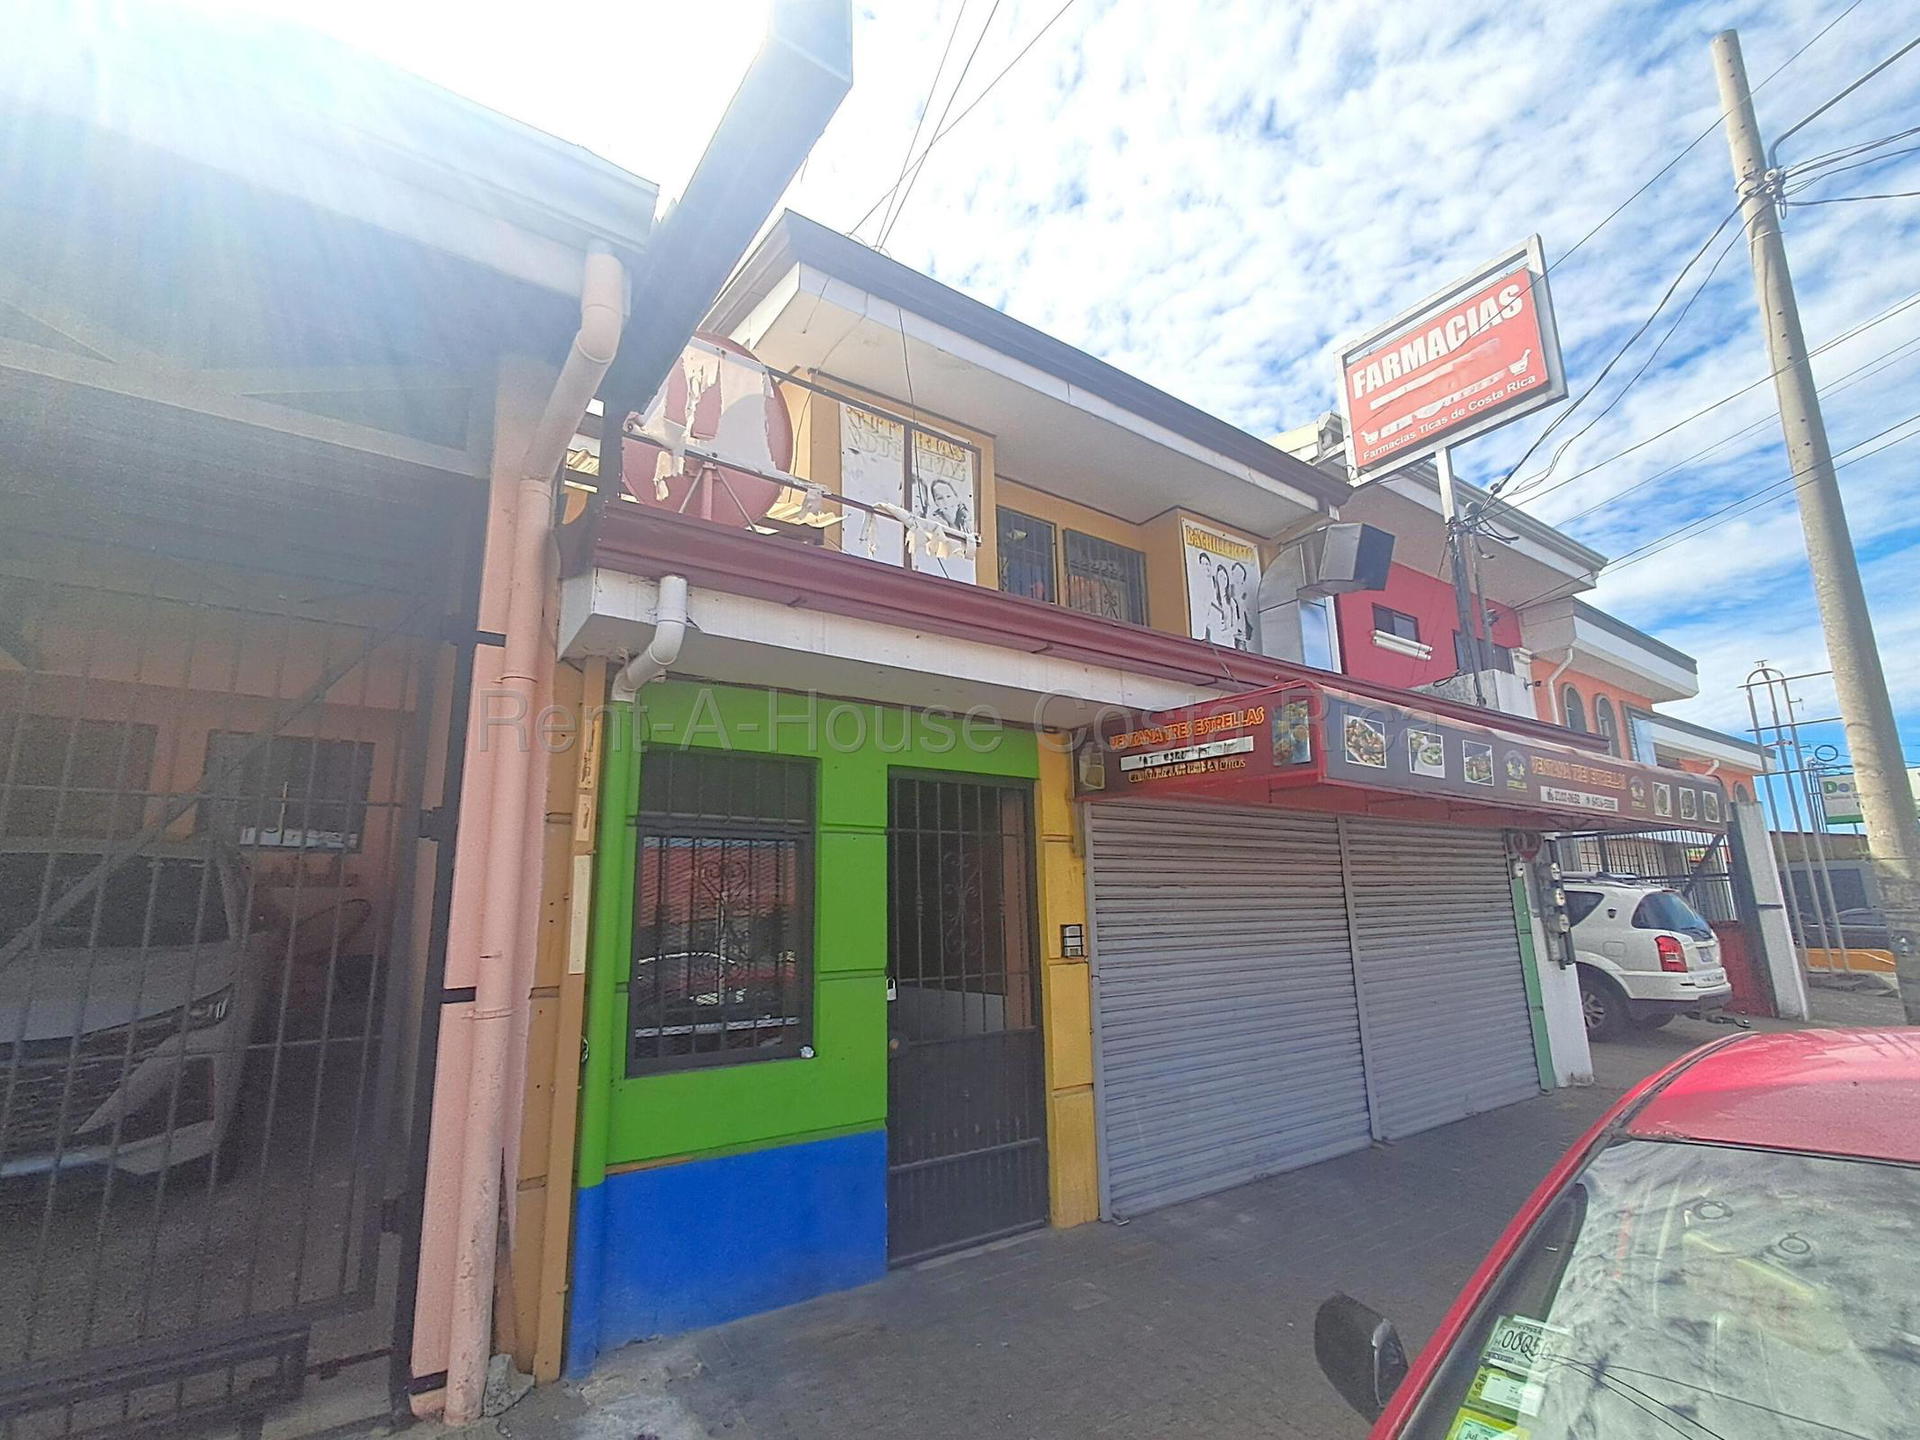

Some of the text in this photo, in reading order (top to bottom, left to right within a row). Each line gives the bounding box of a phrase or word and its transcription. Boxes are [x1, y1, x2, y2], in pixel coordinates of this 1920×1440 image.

[1353, 285, 1522, 399] FARMACIAS
[1363, 375, 1536, 460] Farmacias Ticas de Costa Rica
[1194, 706, 1265, 736] ESTRELLAS
